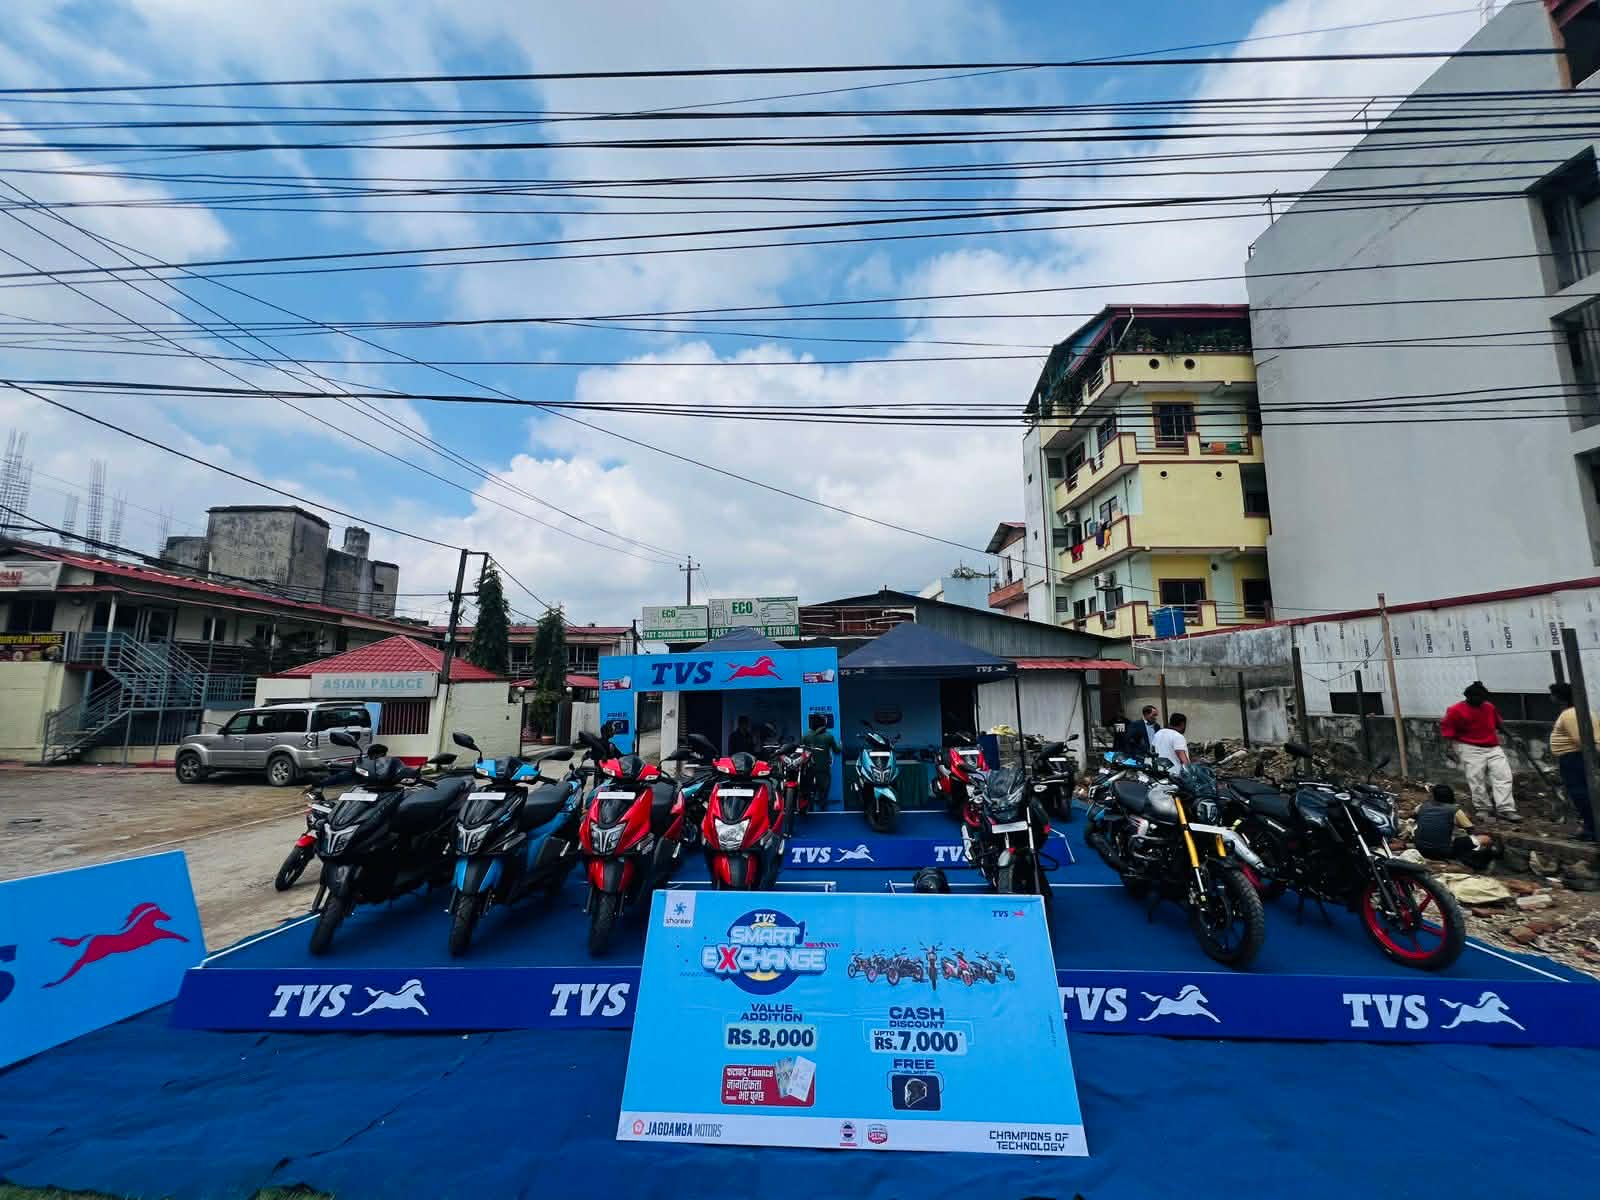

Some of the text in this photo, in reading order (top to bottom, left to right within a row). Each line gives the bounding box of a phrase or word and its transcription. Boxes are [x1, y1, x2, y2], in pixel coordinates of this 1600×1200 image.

[662, 610, 675, 618] ECO
[732, 602, 752, 614] ECO
[644, 631, 656, 640] FAST
[685, 629, 706, 638] STATION
[768, 626, 795, 636] STATION
[652, 661, 713, 685] TVS
[323, 678, 424, 689] ASIAN PALACE
[792, 847, 831, 863] TVS
[934, 846, 968, 862] TV
[754, 913, 776, 923] TVS
[992, 910, 1009, 918] TVS
[730, 926, 800, 944] SMART
[701, 945, 827, 973] EXCHANGE
[269, 984, 352, 1018] TVS
[549, 983, 631, 1016] TVS
[751, 1003, 793, 1012] VALUE
[889, 1006, 945, 1020] CASH
[1343, 993, 1429, 1030] TVS
[741, 1012, 802, 1022] ADDITION
[889, 1020, 944, 1029] DISCOUNT
[893, 1058, 936, 1070] FREE
[747, 1067, 774, 1077] Finance
[645, 1121, 721, 1138] JAGDAMBA MOTORS
[989, 1130, 1069, 1142] CHAMPIONS OF
[996, 1141, 1065, 1151] TECHNOLOGY
